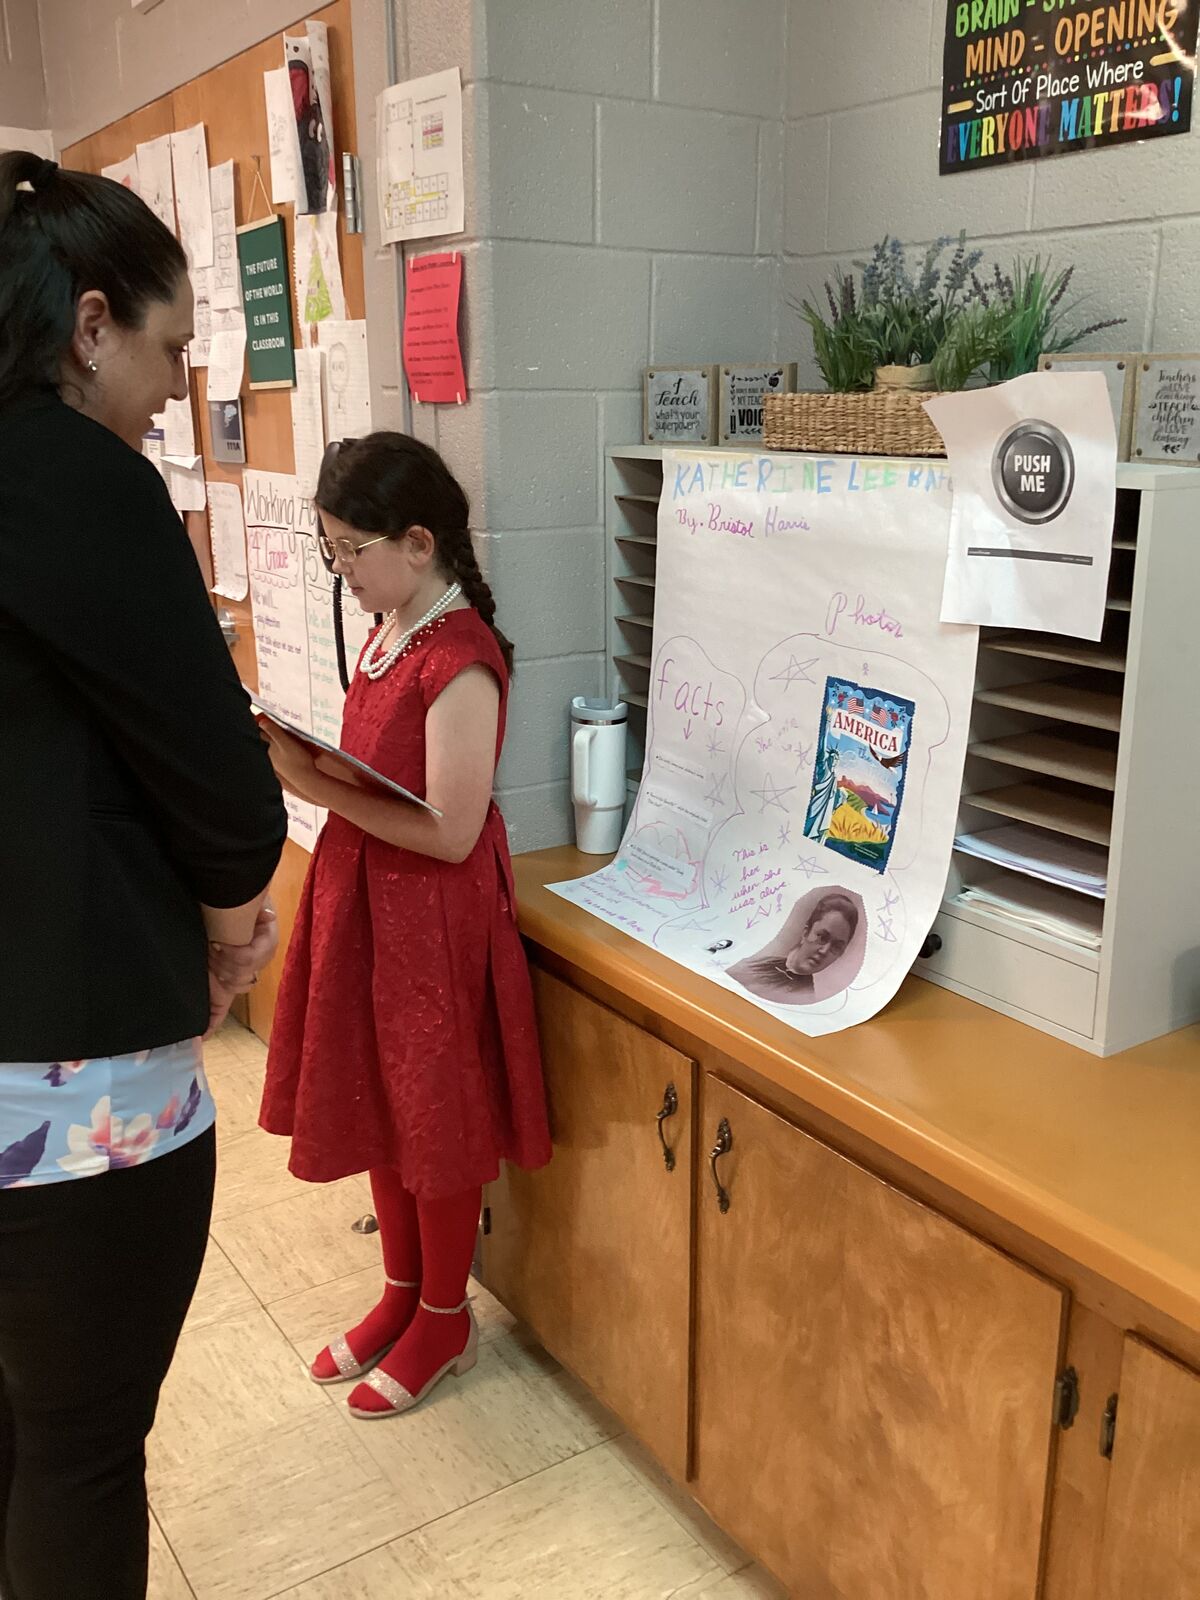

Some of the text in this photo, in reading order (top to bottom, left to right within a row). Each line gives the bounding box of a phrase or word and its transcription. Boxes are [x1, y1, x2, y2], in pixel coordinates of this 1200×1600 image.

[955, 0, 1019, 38] BRAIN
[965, 29, 1026, 78] MIND
[1054, 0, 1179, 55] OPENING
[975, 60, 1145, 113] Sort Of Place Where
[946, 76, 1182, 163] EVERYONE MATTERS!
[245, 257, 278, 275] THE FUTURE
[245, 282, 284, 301] OF THE WORLD
[253, 311, 279, 326] IS IN THIS
[252, 336, 286, 351] CLASSROOM
[655, 390, 699, 406] Teach
[679, 409, 700, 422] your
[738, 408, 764, 427] VOIC
[655, 420, 700, 434] superpower?
[1014, 454, 1051, 473] PUSH
[673, 458, 836, 500] KATHERINE
[848, 460, 898, 491] LEE
[1020, 475, 1046, 492] ME
[245, 476, 295, 553] Working
[708, 503, 755, 538] Bristol
[825, 592, 904, 638] Photos
[657, 658, 725, 727] facts
[832, 711, 899, 753] AMERICA
[731, 842, 770, 862] This is
[739, 866, 760, 882] her
[731, 868, 782, 901] when she
[728, 897, 756, 914] was
